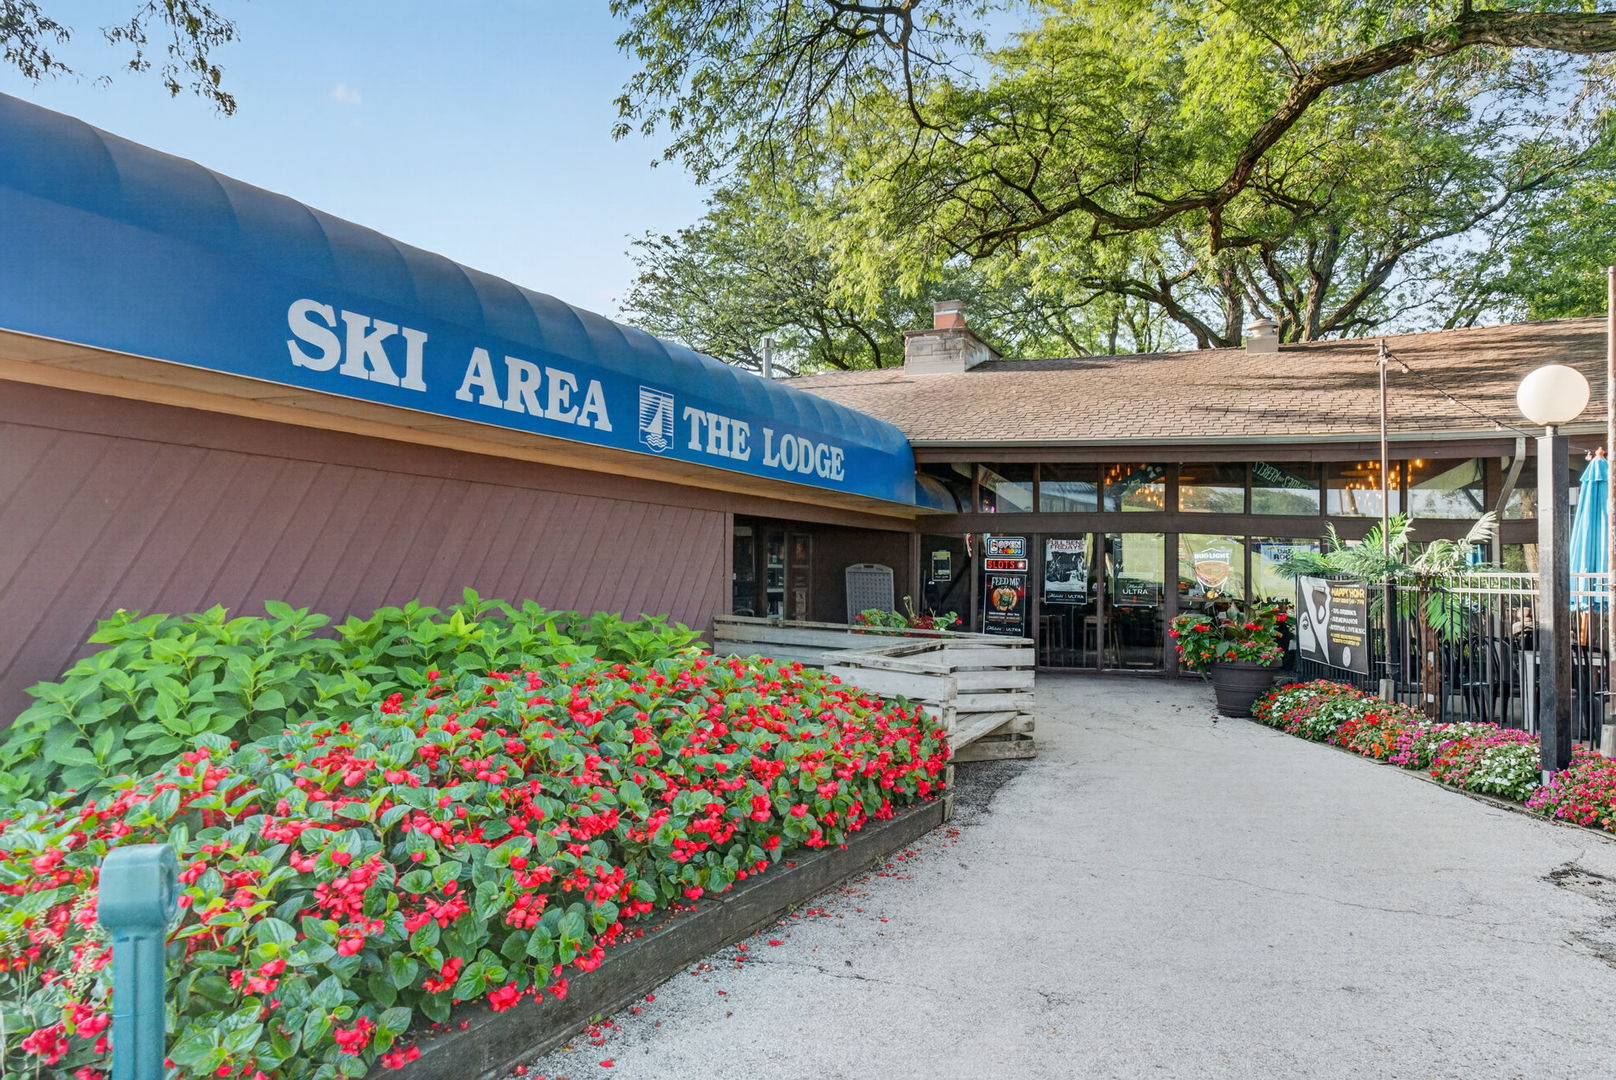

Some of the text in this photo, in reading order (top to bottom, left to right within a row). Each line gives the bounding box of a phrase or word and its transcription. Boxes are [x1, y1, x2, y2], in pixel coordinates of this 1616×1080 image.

[286, 297, 613, 432] SKI AREA
[682, 405, 846, 482] THE LODGE
[998, 540, 1021, 549] OPEN
[987, 560, 1015, 569] SLOTS
[991, 577, 1009, 589] FEED
